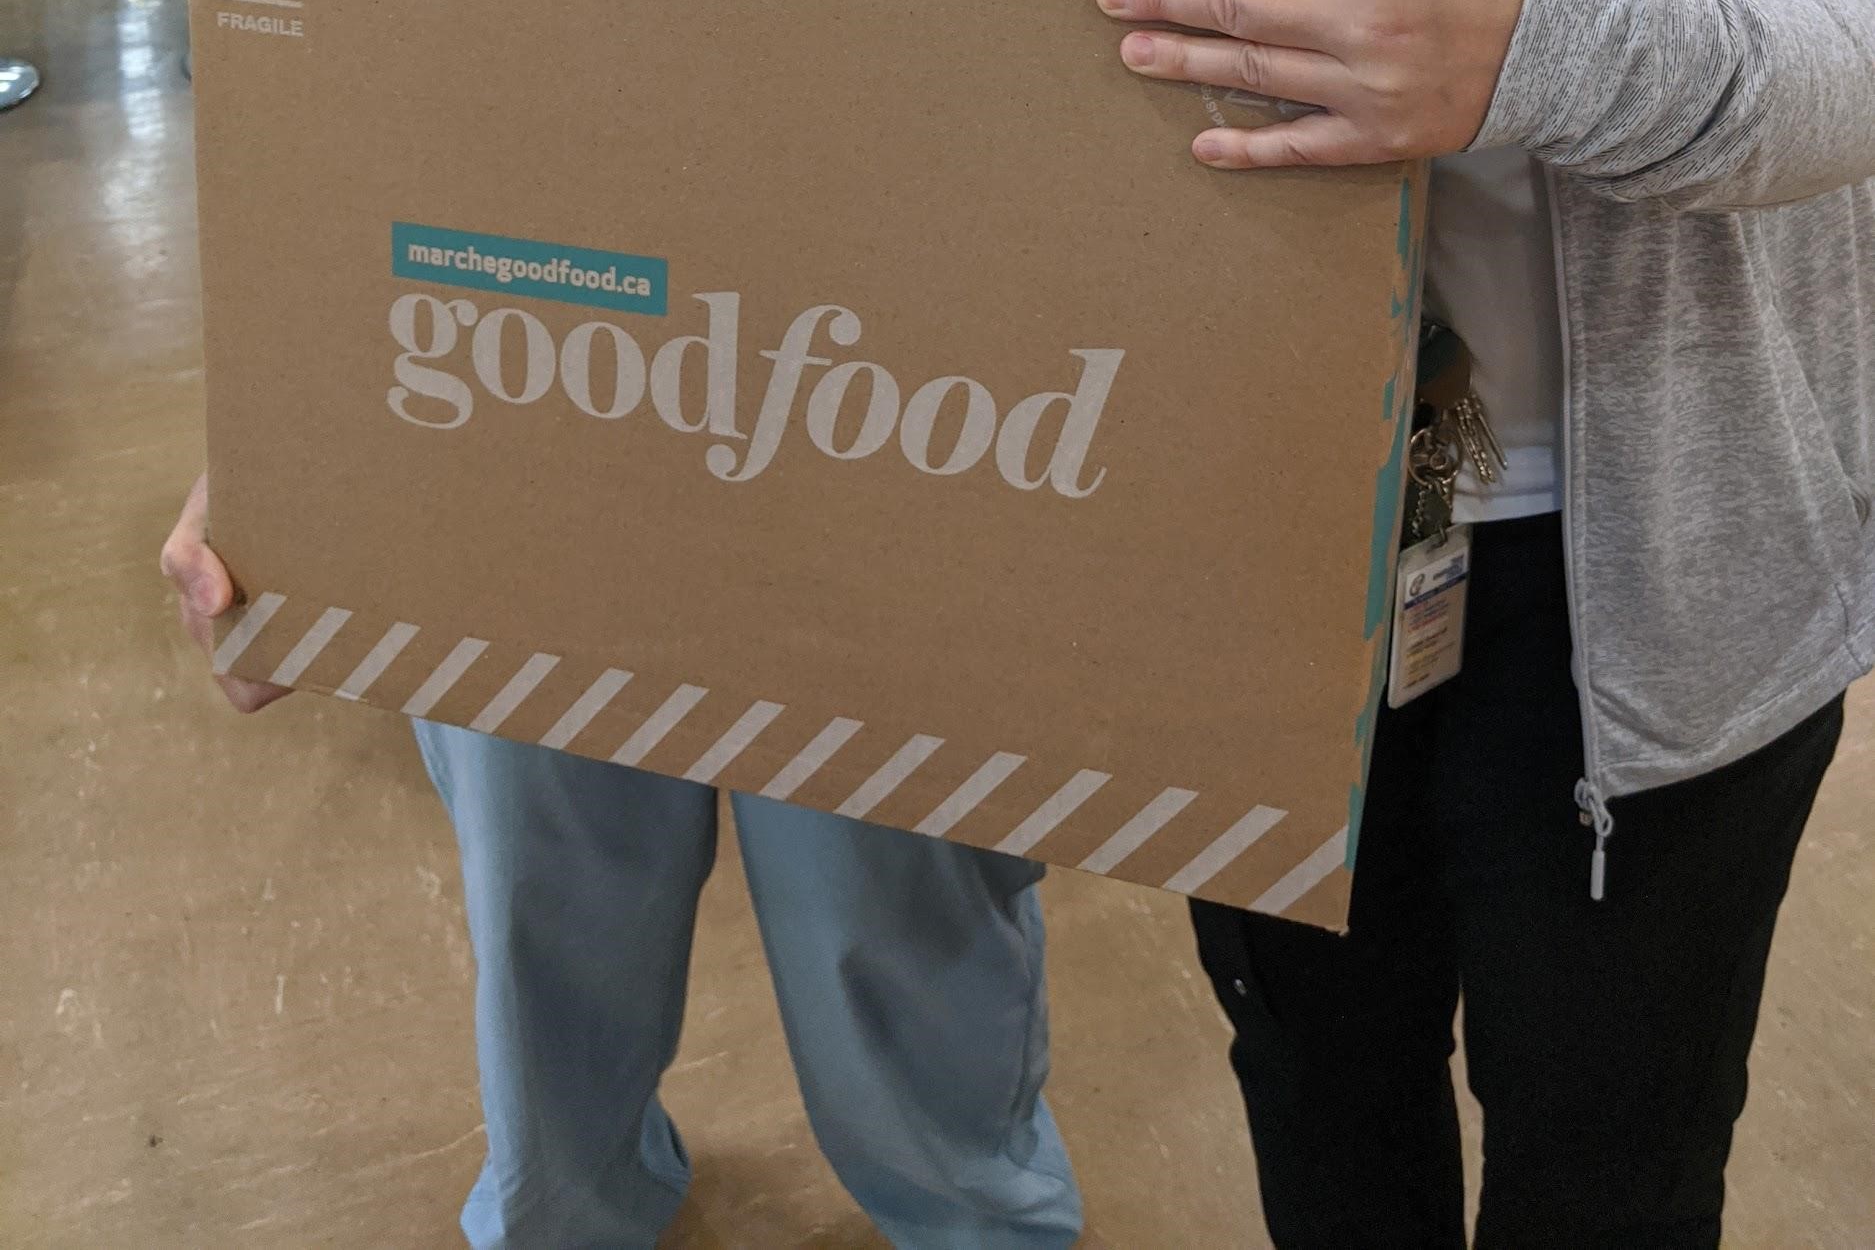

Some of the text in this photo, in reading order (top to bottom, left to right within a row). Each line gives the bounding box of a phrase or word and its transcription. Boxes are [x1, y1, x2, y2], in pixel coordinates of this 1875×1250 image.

[216, 11, 305, 38] FRAGILE
[407, 242, 652, 297] marchegoodfood.ca
[386, 290, 1126, 499] goodfood
